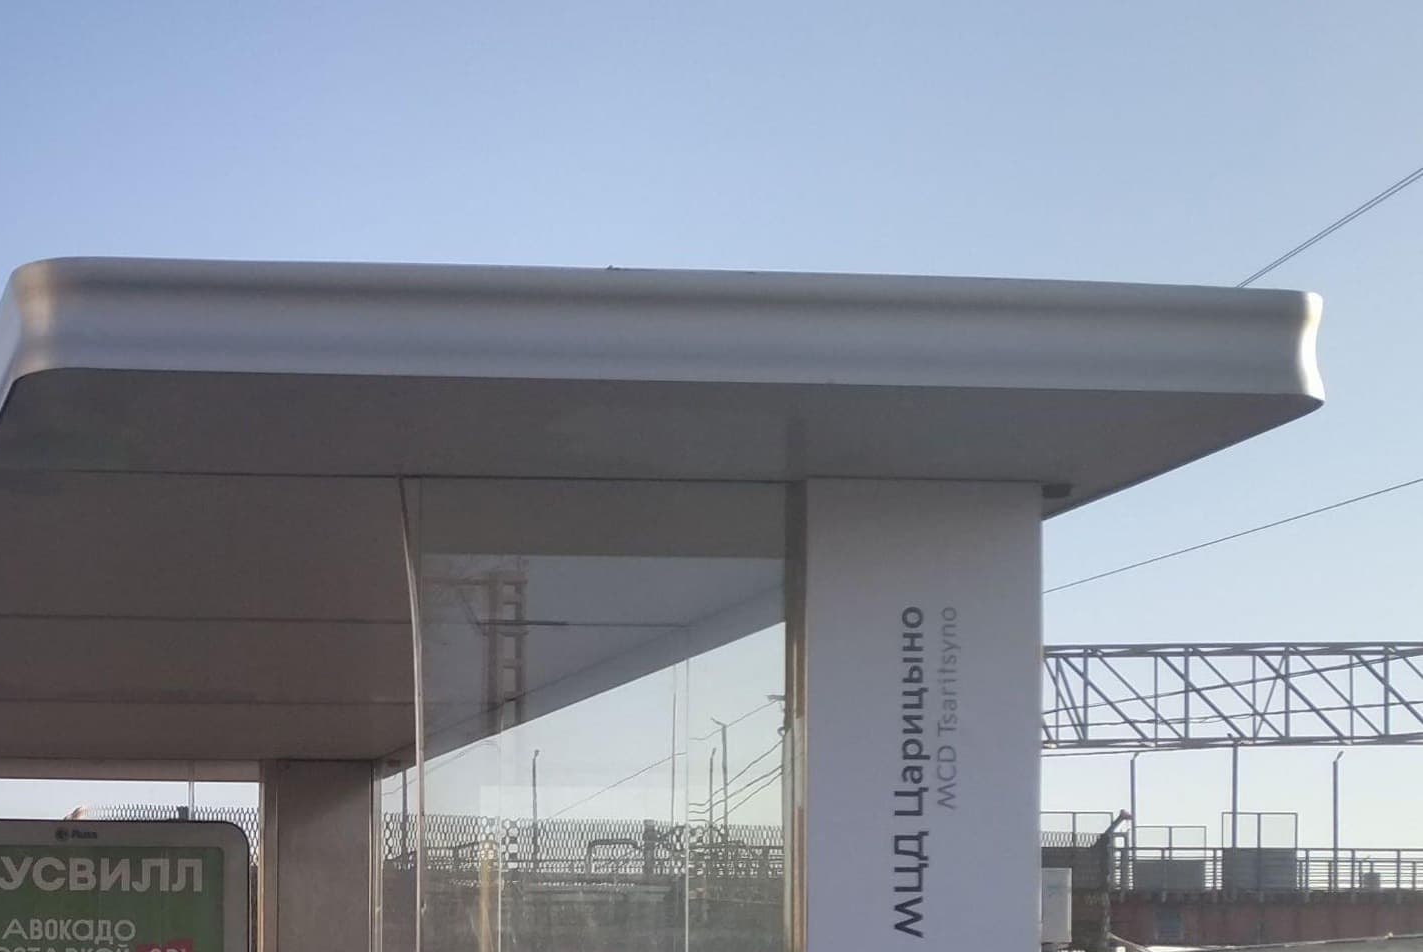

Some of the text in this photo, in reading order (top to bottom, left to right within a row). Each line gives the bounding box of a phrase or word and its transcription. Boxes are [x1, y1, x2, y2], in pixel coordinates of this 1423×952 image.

[894, 606, 930, 939] МЦД Царицыно
[937, 606, 962, 810] MCD Tsaritsyno
[1, 918, 137, 945] АВОКАДО
